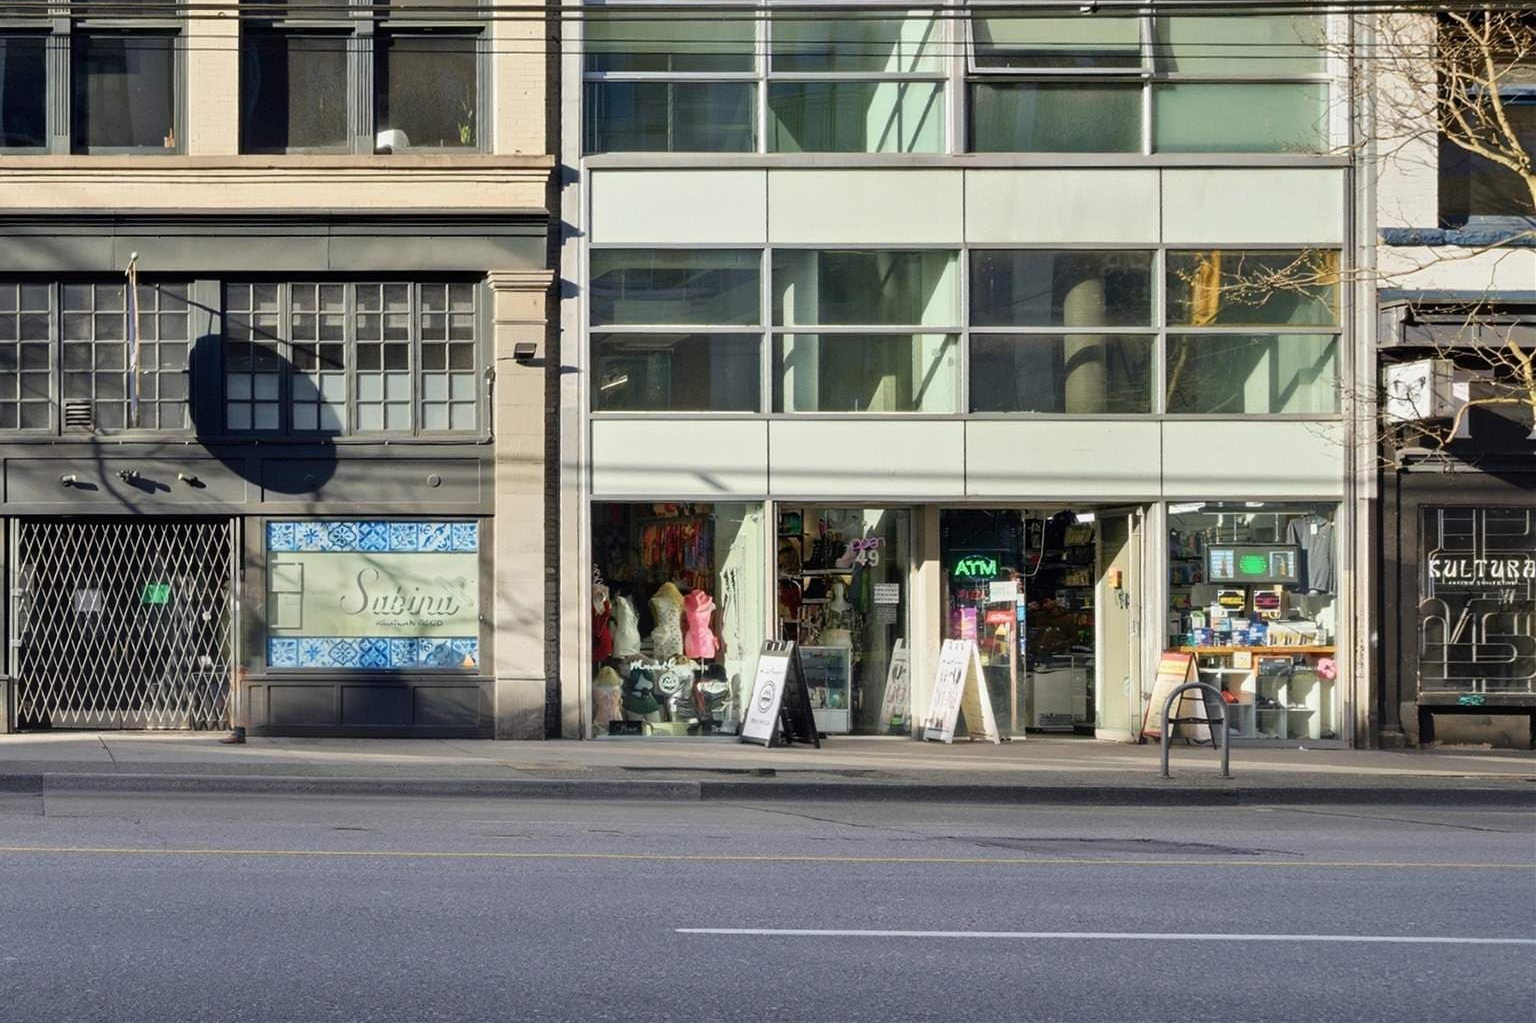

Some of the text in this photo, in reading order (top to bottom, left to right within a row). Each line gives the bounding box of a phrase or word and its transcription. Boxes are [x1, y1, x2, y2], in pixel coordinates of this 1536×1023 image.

[855, 550, 879, 567] 49
[954, 559, 997, 576] ATM
[1429, 560, 1536, 578] KULTURA
[339, 568, 460, 616] Sabina
